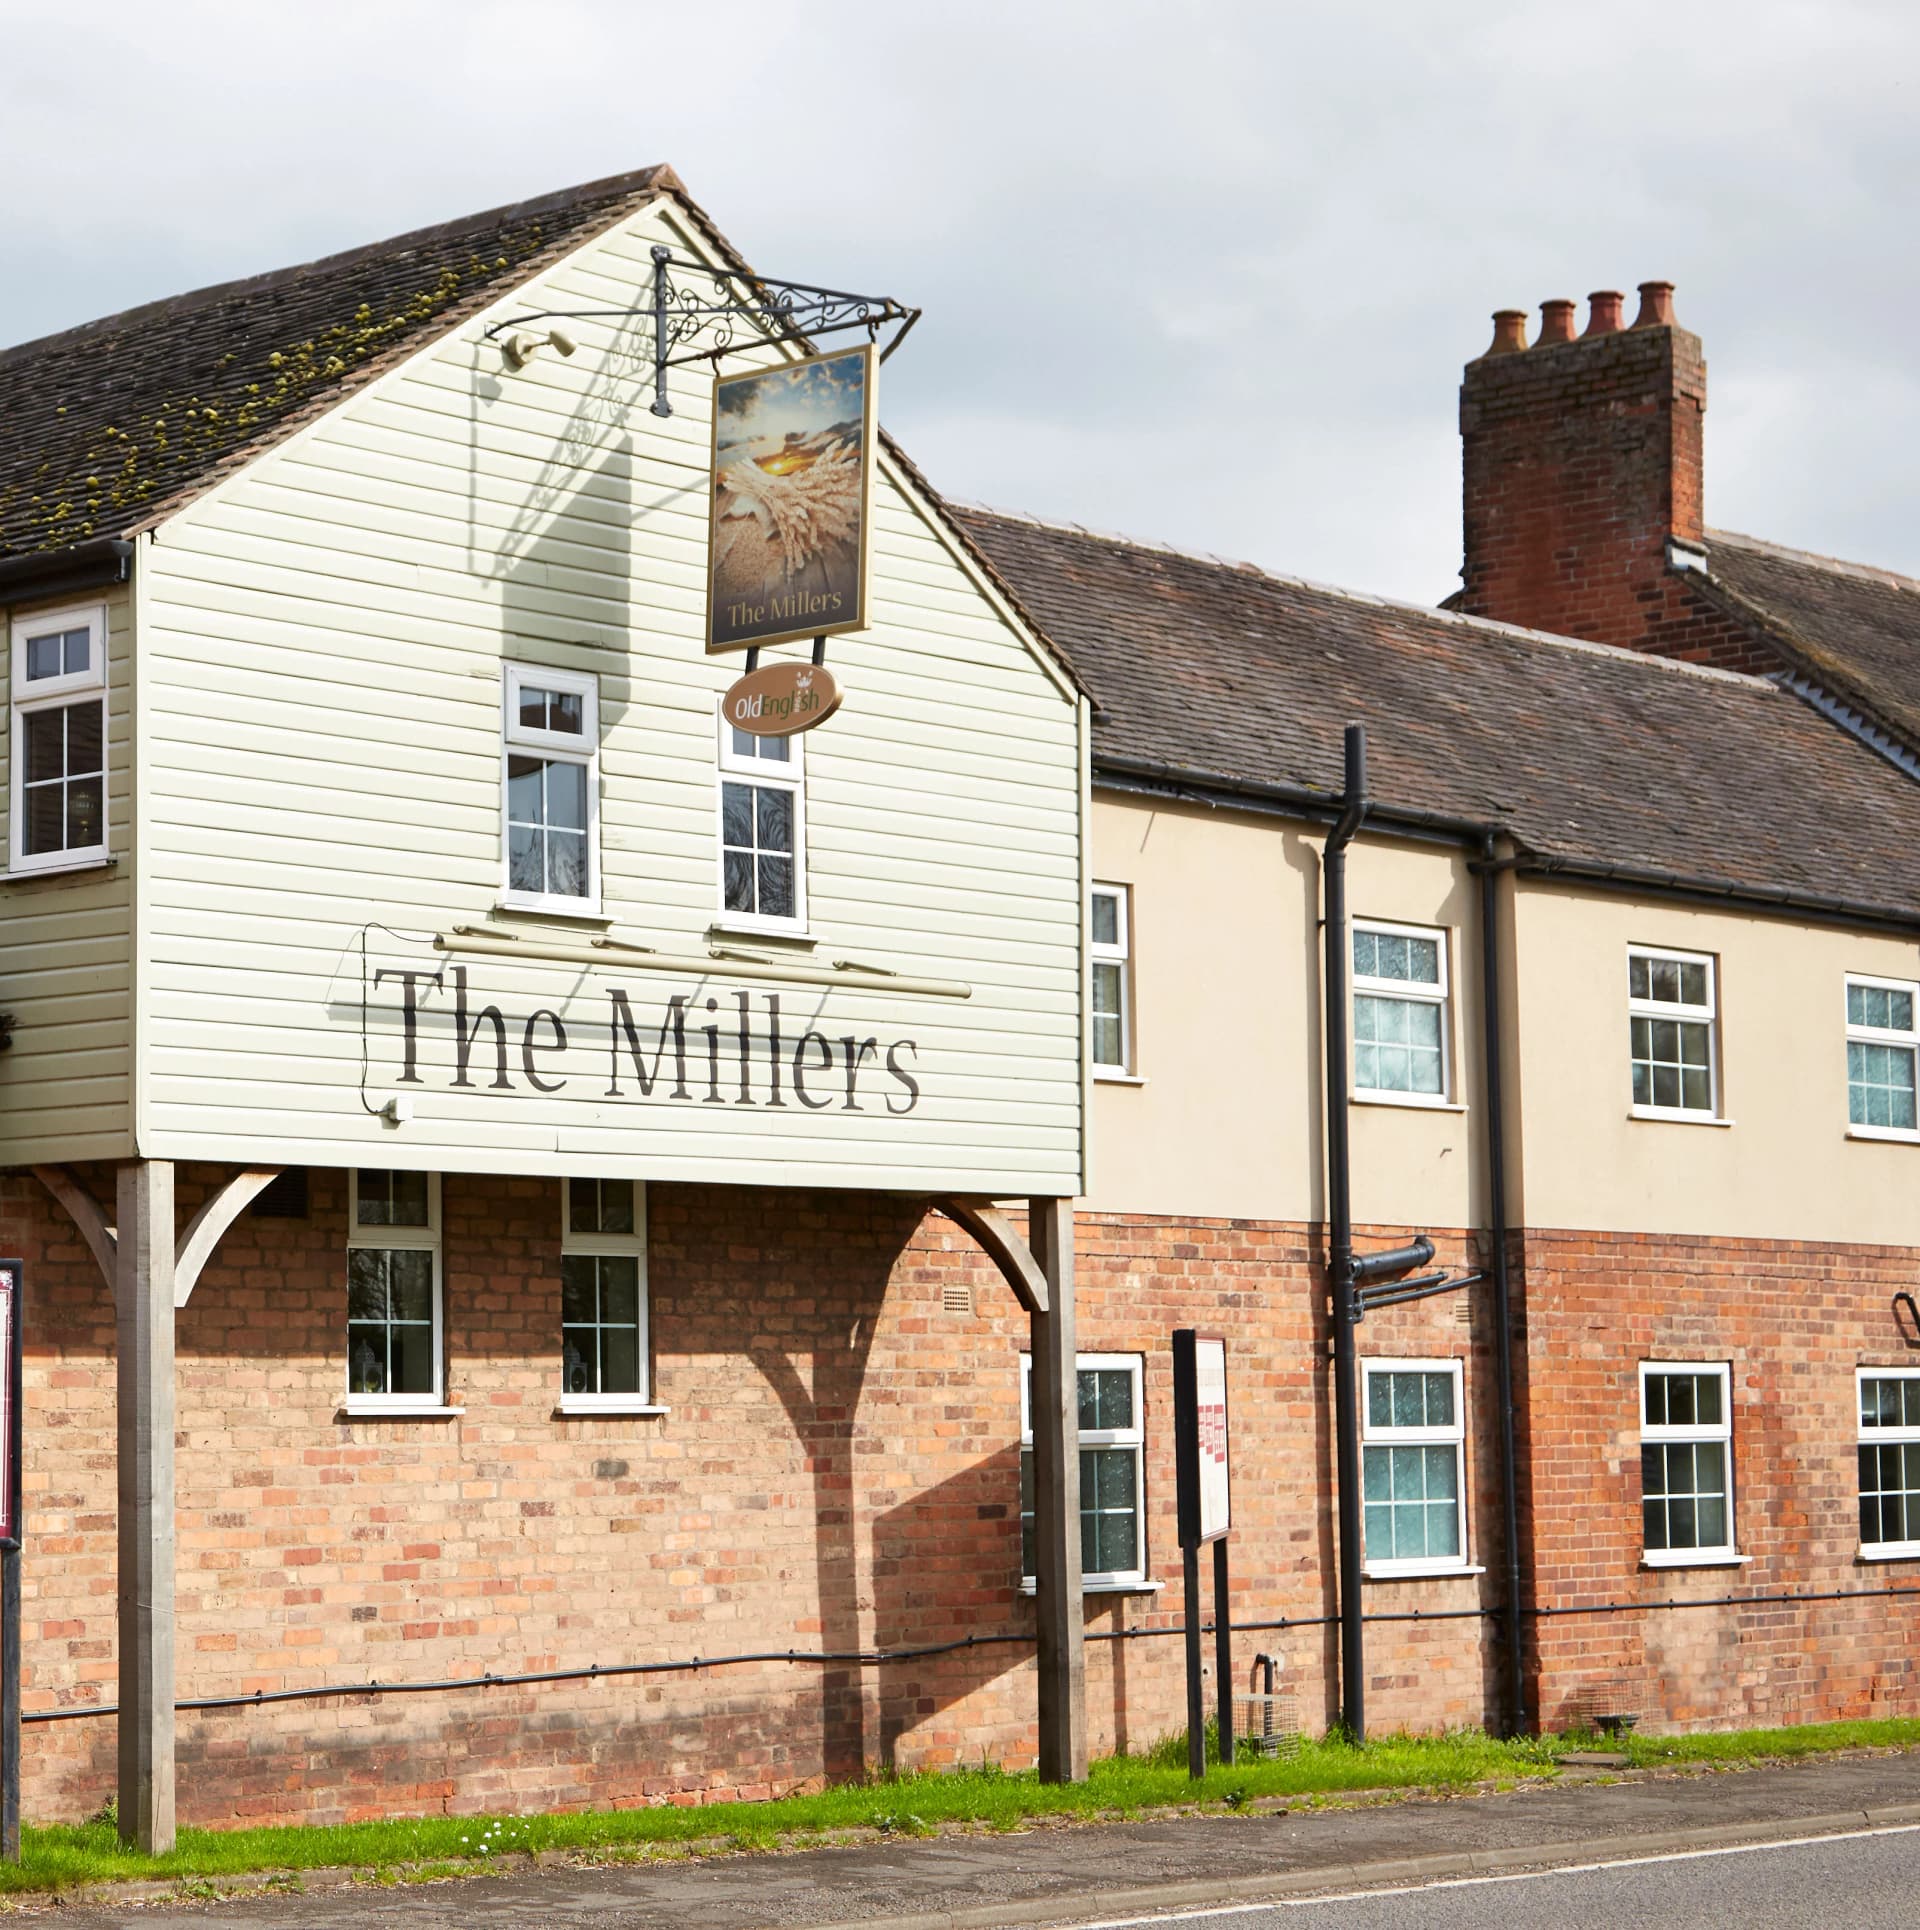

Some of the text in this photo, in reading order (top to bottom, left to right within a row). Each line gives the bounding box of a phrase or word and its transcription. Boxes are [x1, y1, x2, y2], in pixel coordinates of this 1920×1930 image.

[728, 591, 842, 627] The Millers
[373, 965, 921, 1114] The Millers
